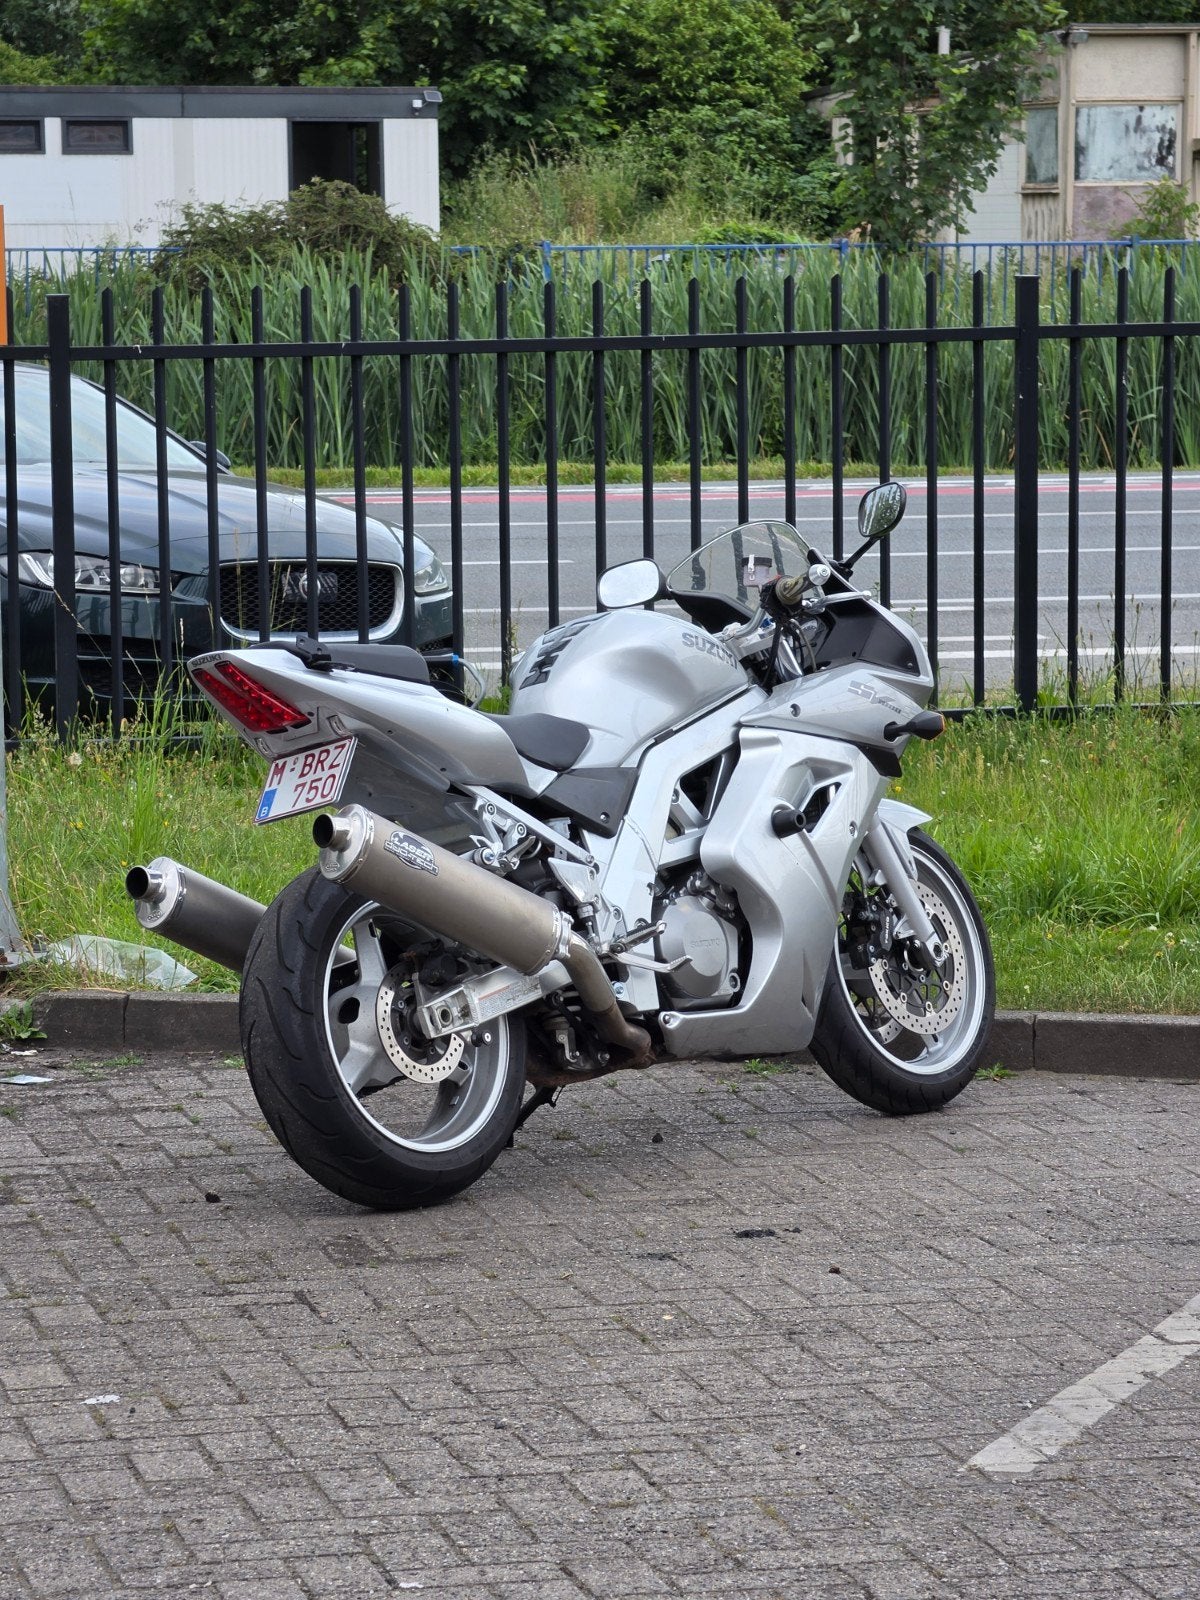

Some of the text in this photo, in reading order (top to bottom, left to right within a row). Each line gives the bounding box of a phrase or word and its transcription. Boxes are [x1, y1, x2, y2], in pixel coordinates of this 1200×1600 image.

[191, 654, 222, 667] SUZUKI
[681, 632, 738, 670] SUZUKI
[291, 774, 336, 808] 750
[260, 806, 269, 817] B
[393, 837, 433, 861] LASER
